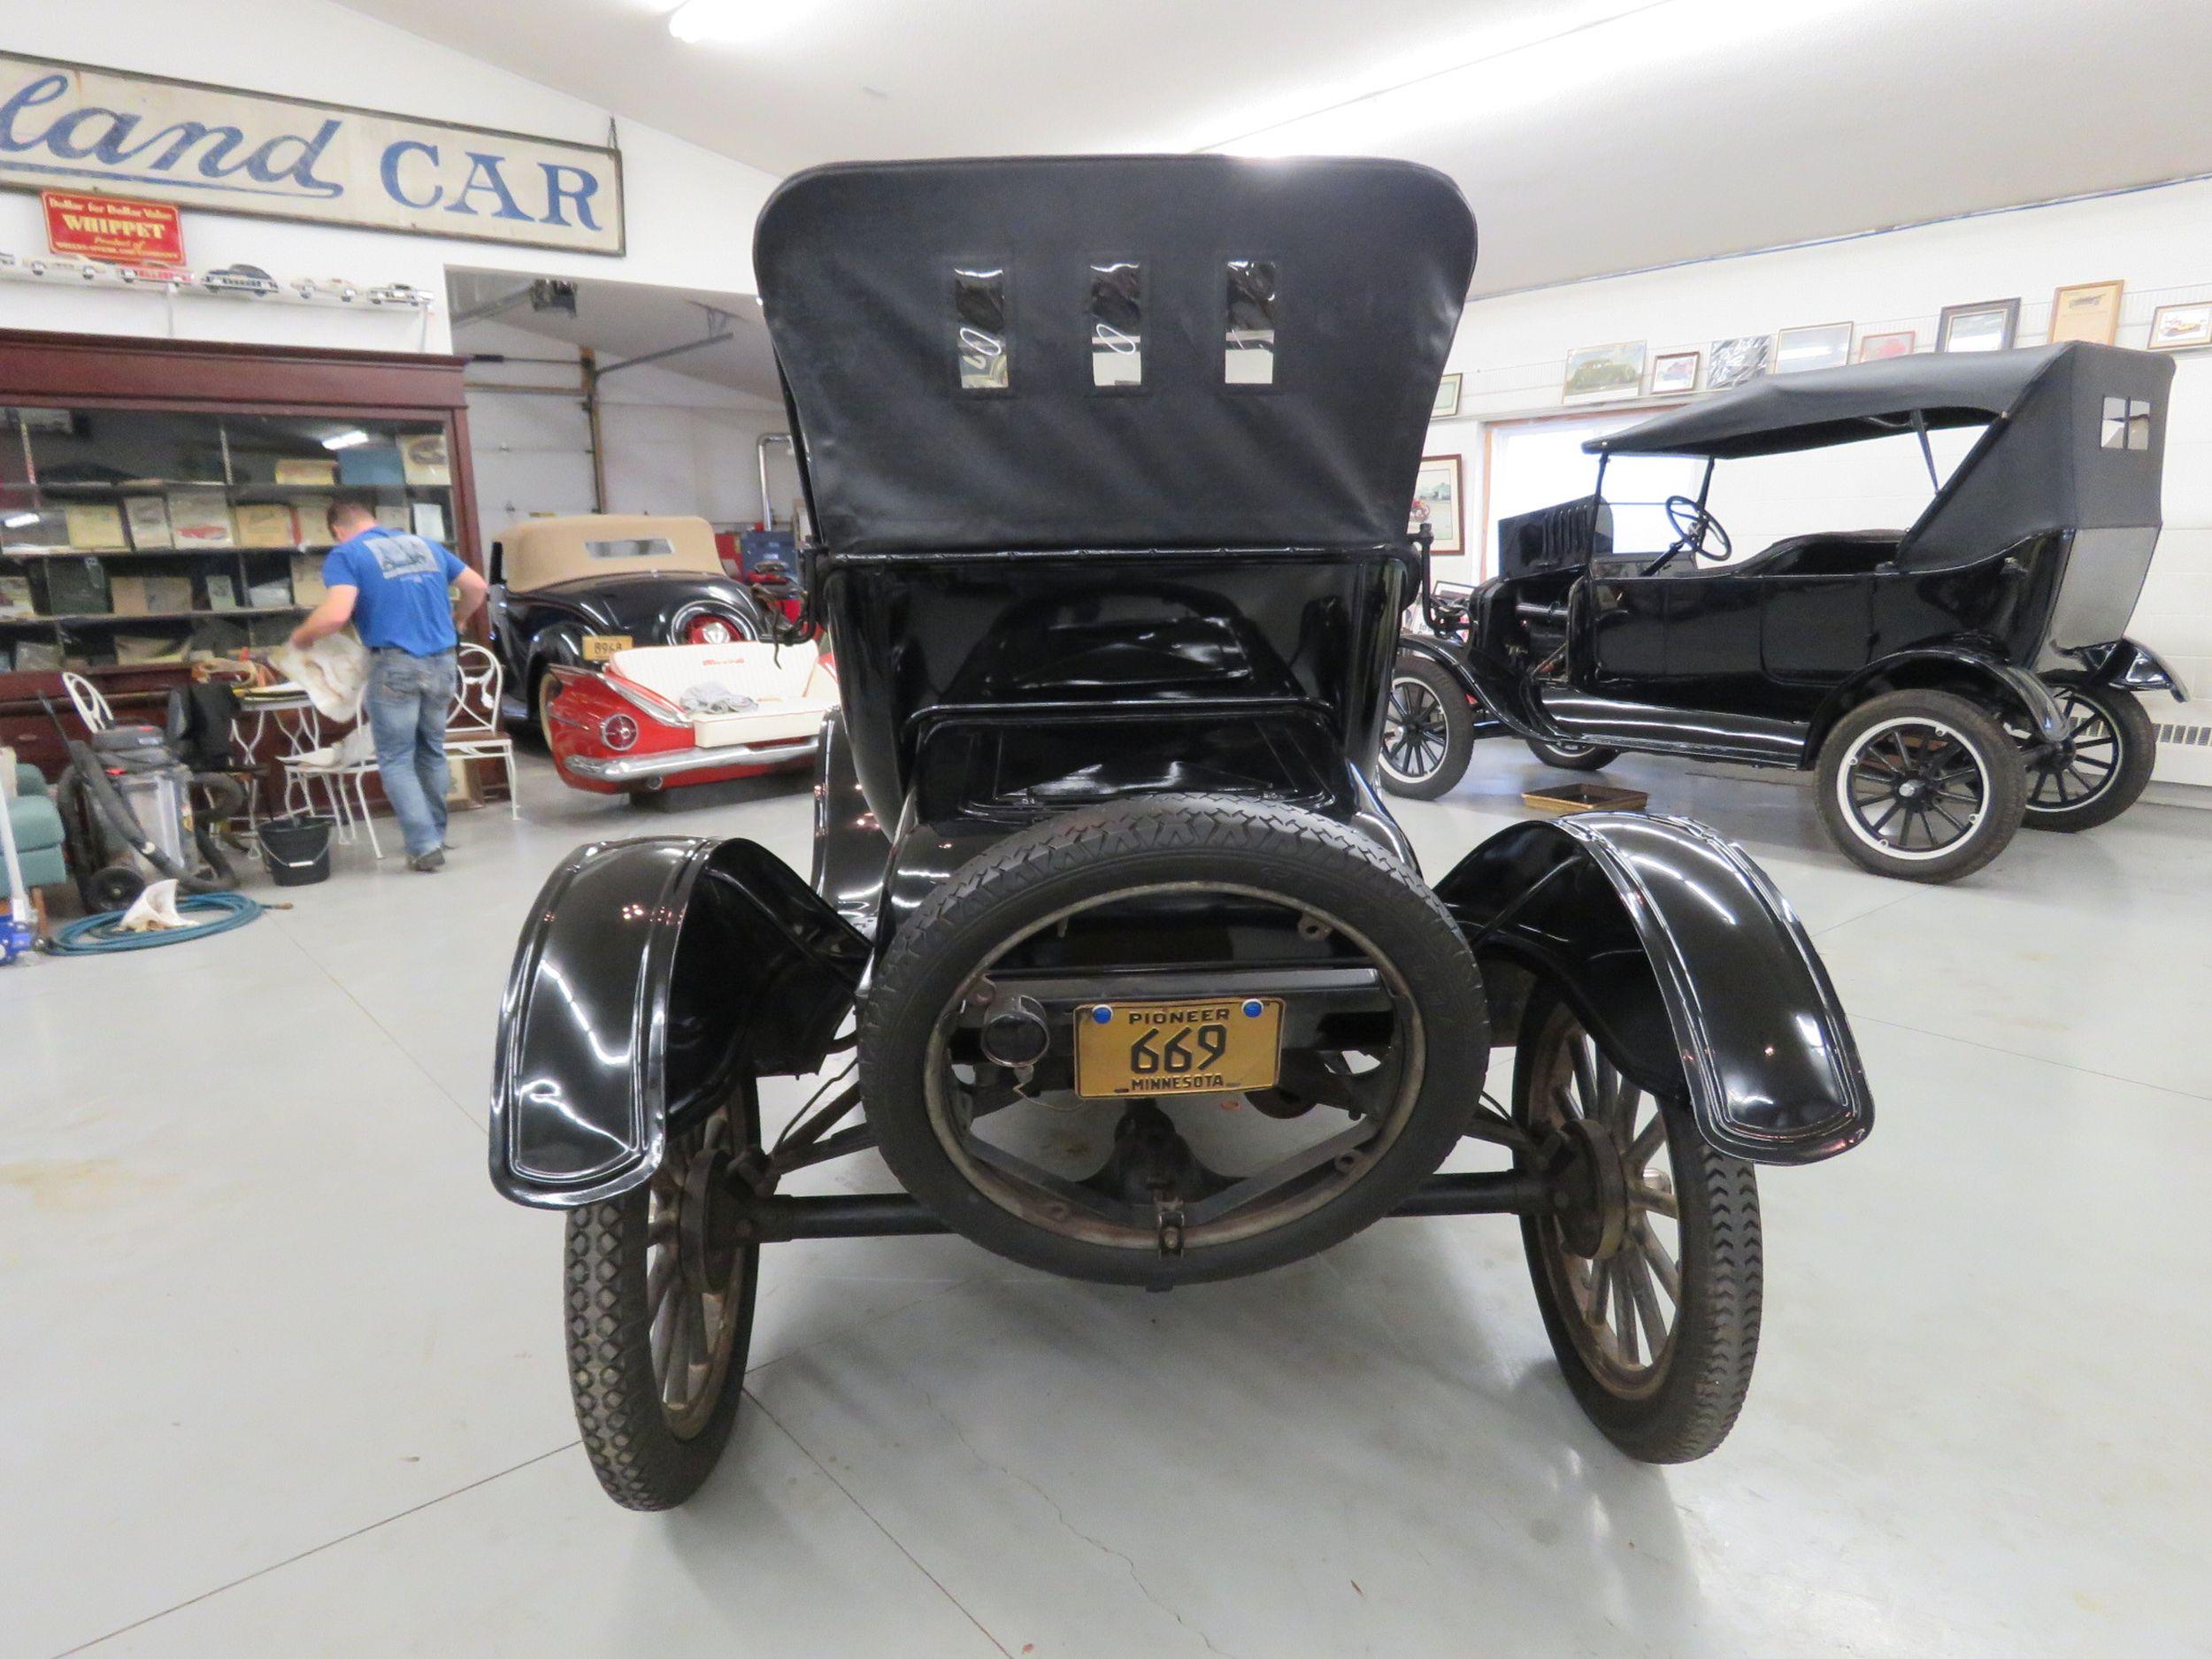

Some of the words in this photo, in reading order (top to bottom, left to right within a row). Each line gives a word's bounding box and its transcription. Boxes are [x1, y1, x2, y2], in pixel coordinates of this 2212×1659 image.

[380, 141, 603, 231] CAR
[62, 213, 165, 239] WHIPPET
[1129, 1008, 1230, 1025] PIONEER
[1131, 1023, 1227, 1074] 669
[1131, 1073, 1225, 1091] MINNESOTA
